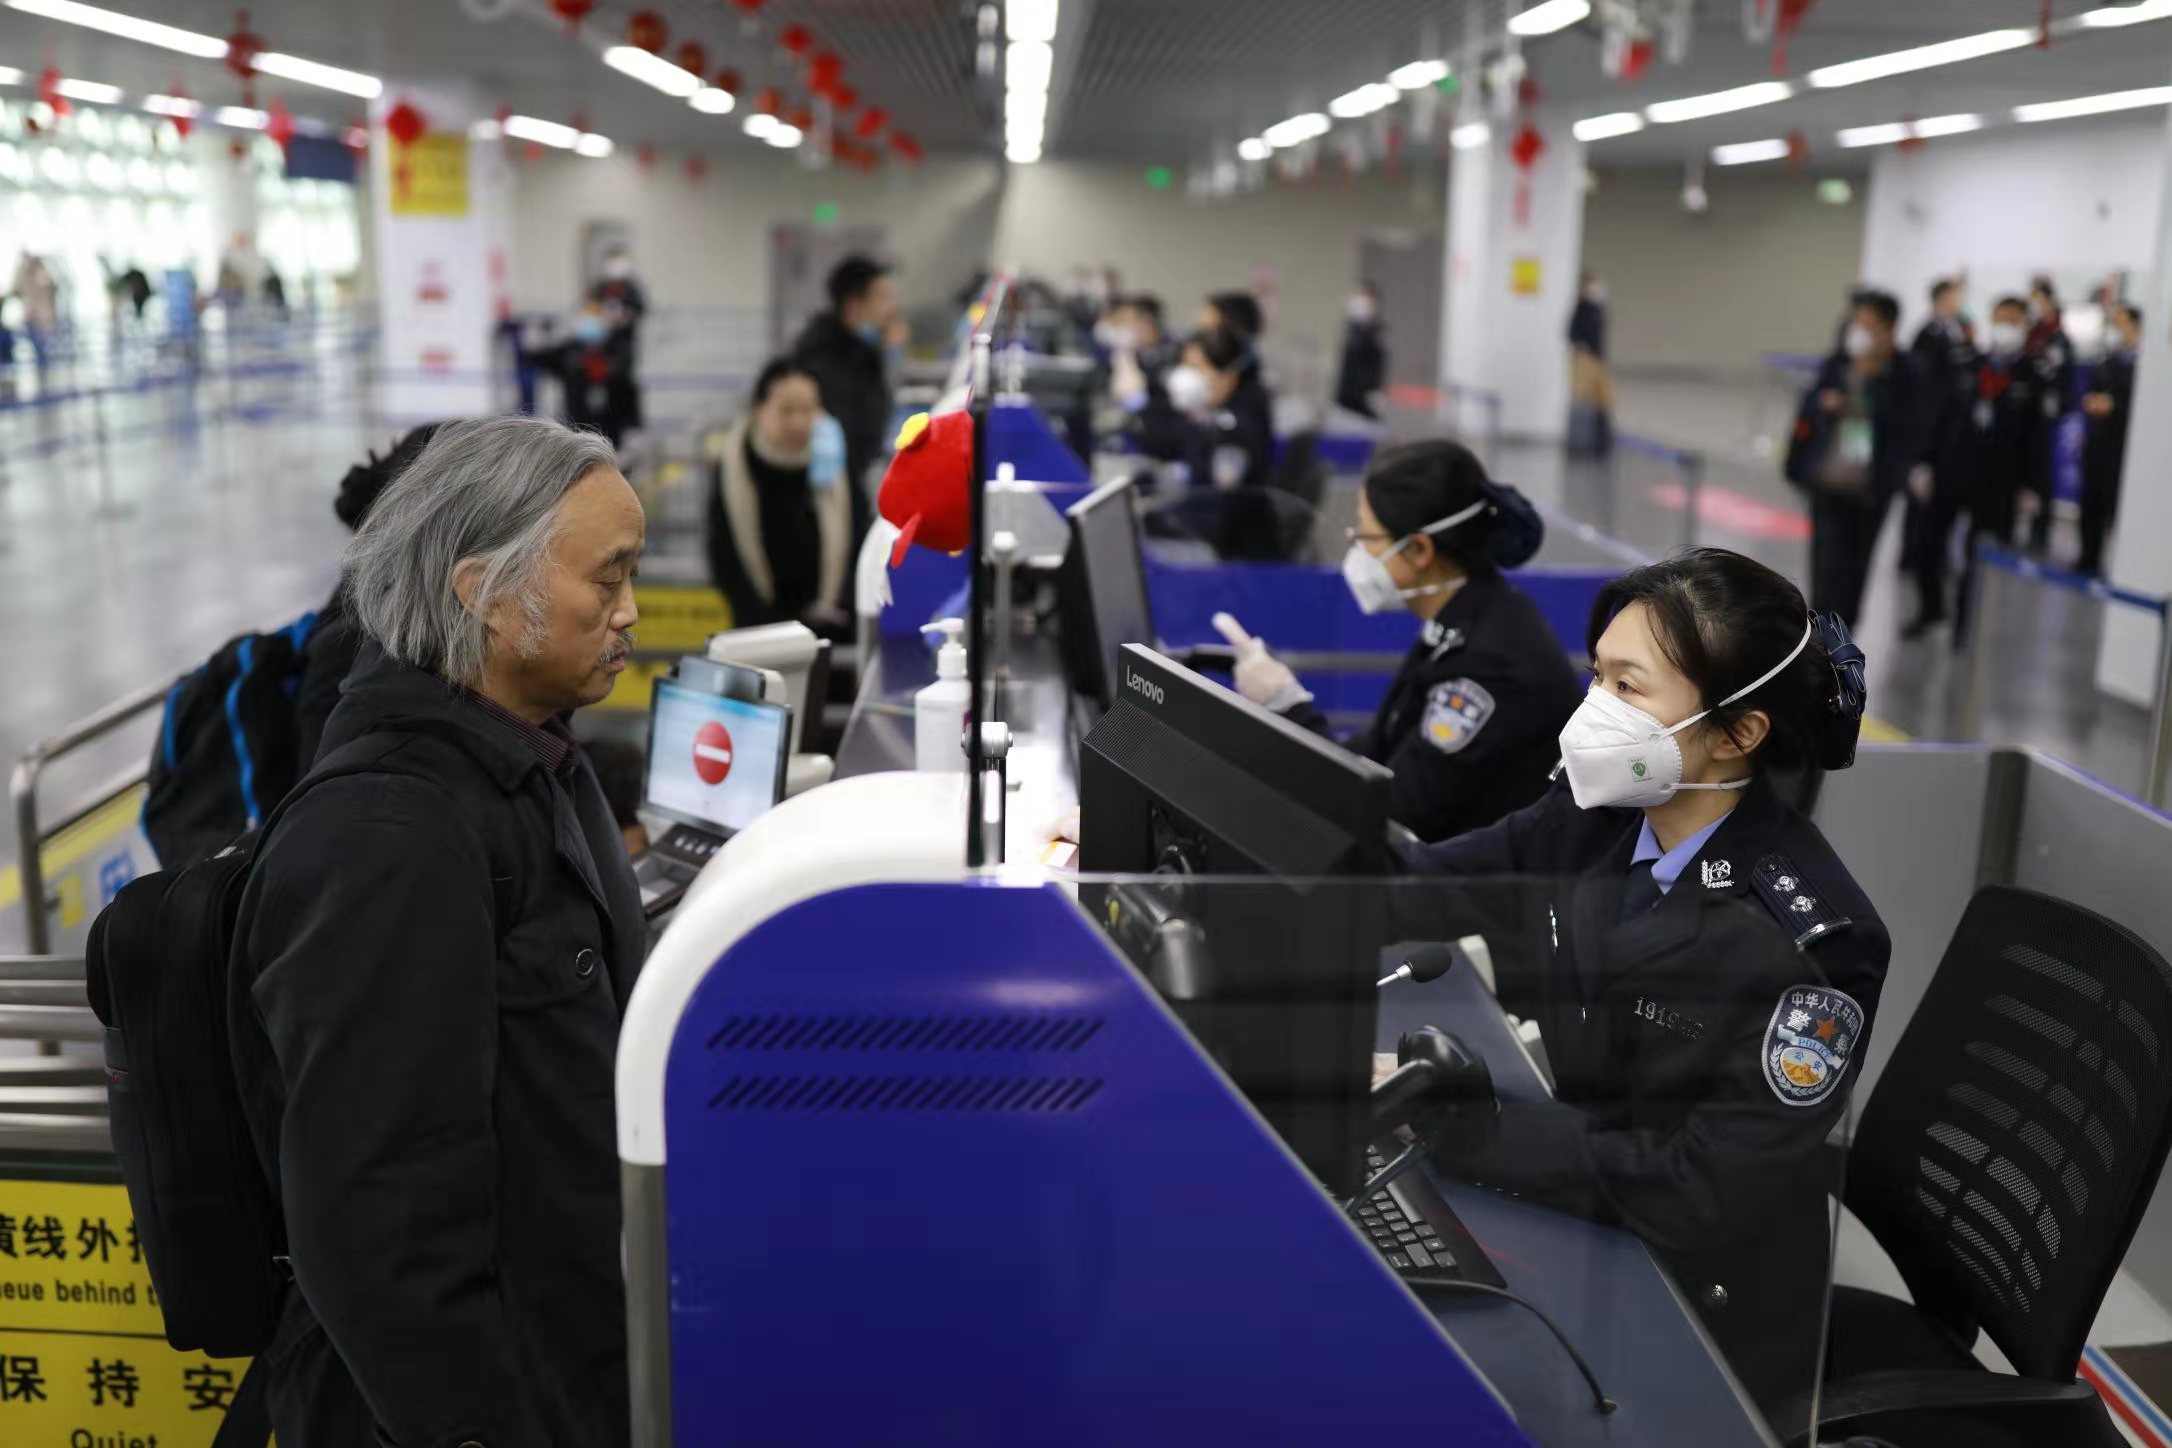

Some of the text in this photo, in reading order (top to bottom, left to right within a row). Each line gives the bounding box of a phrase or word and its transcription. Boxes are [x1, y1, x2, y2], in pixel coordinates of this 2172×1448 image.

[1127, 665, 1164, 704] Lenovo
[0, 1280, 45, 1301] eue
[55, 1279, 137, 1306] behind
[71, 1427, 158, 1448] Quiet
